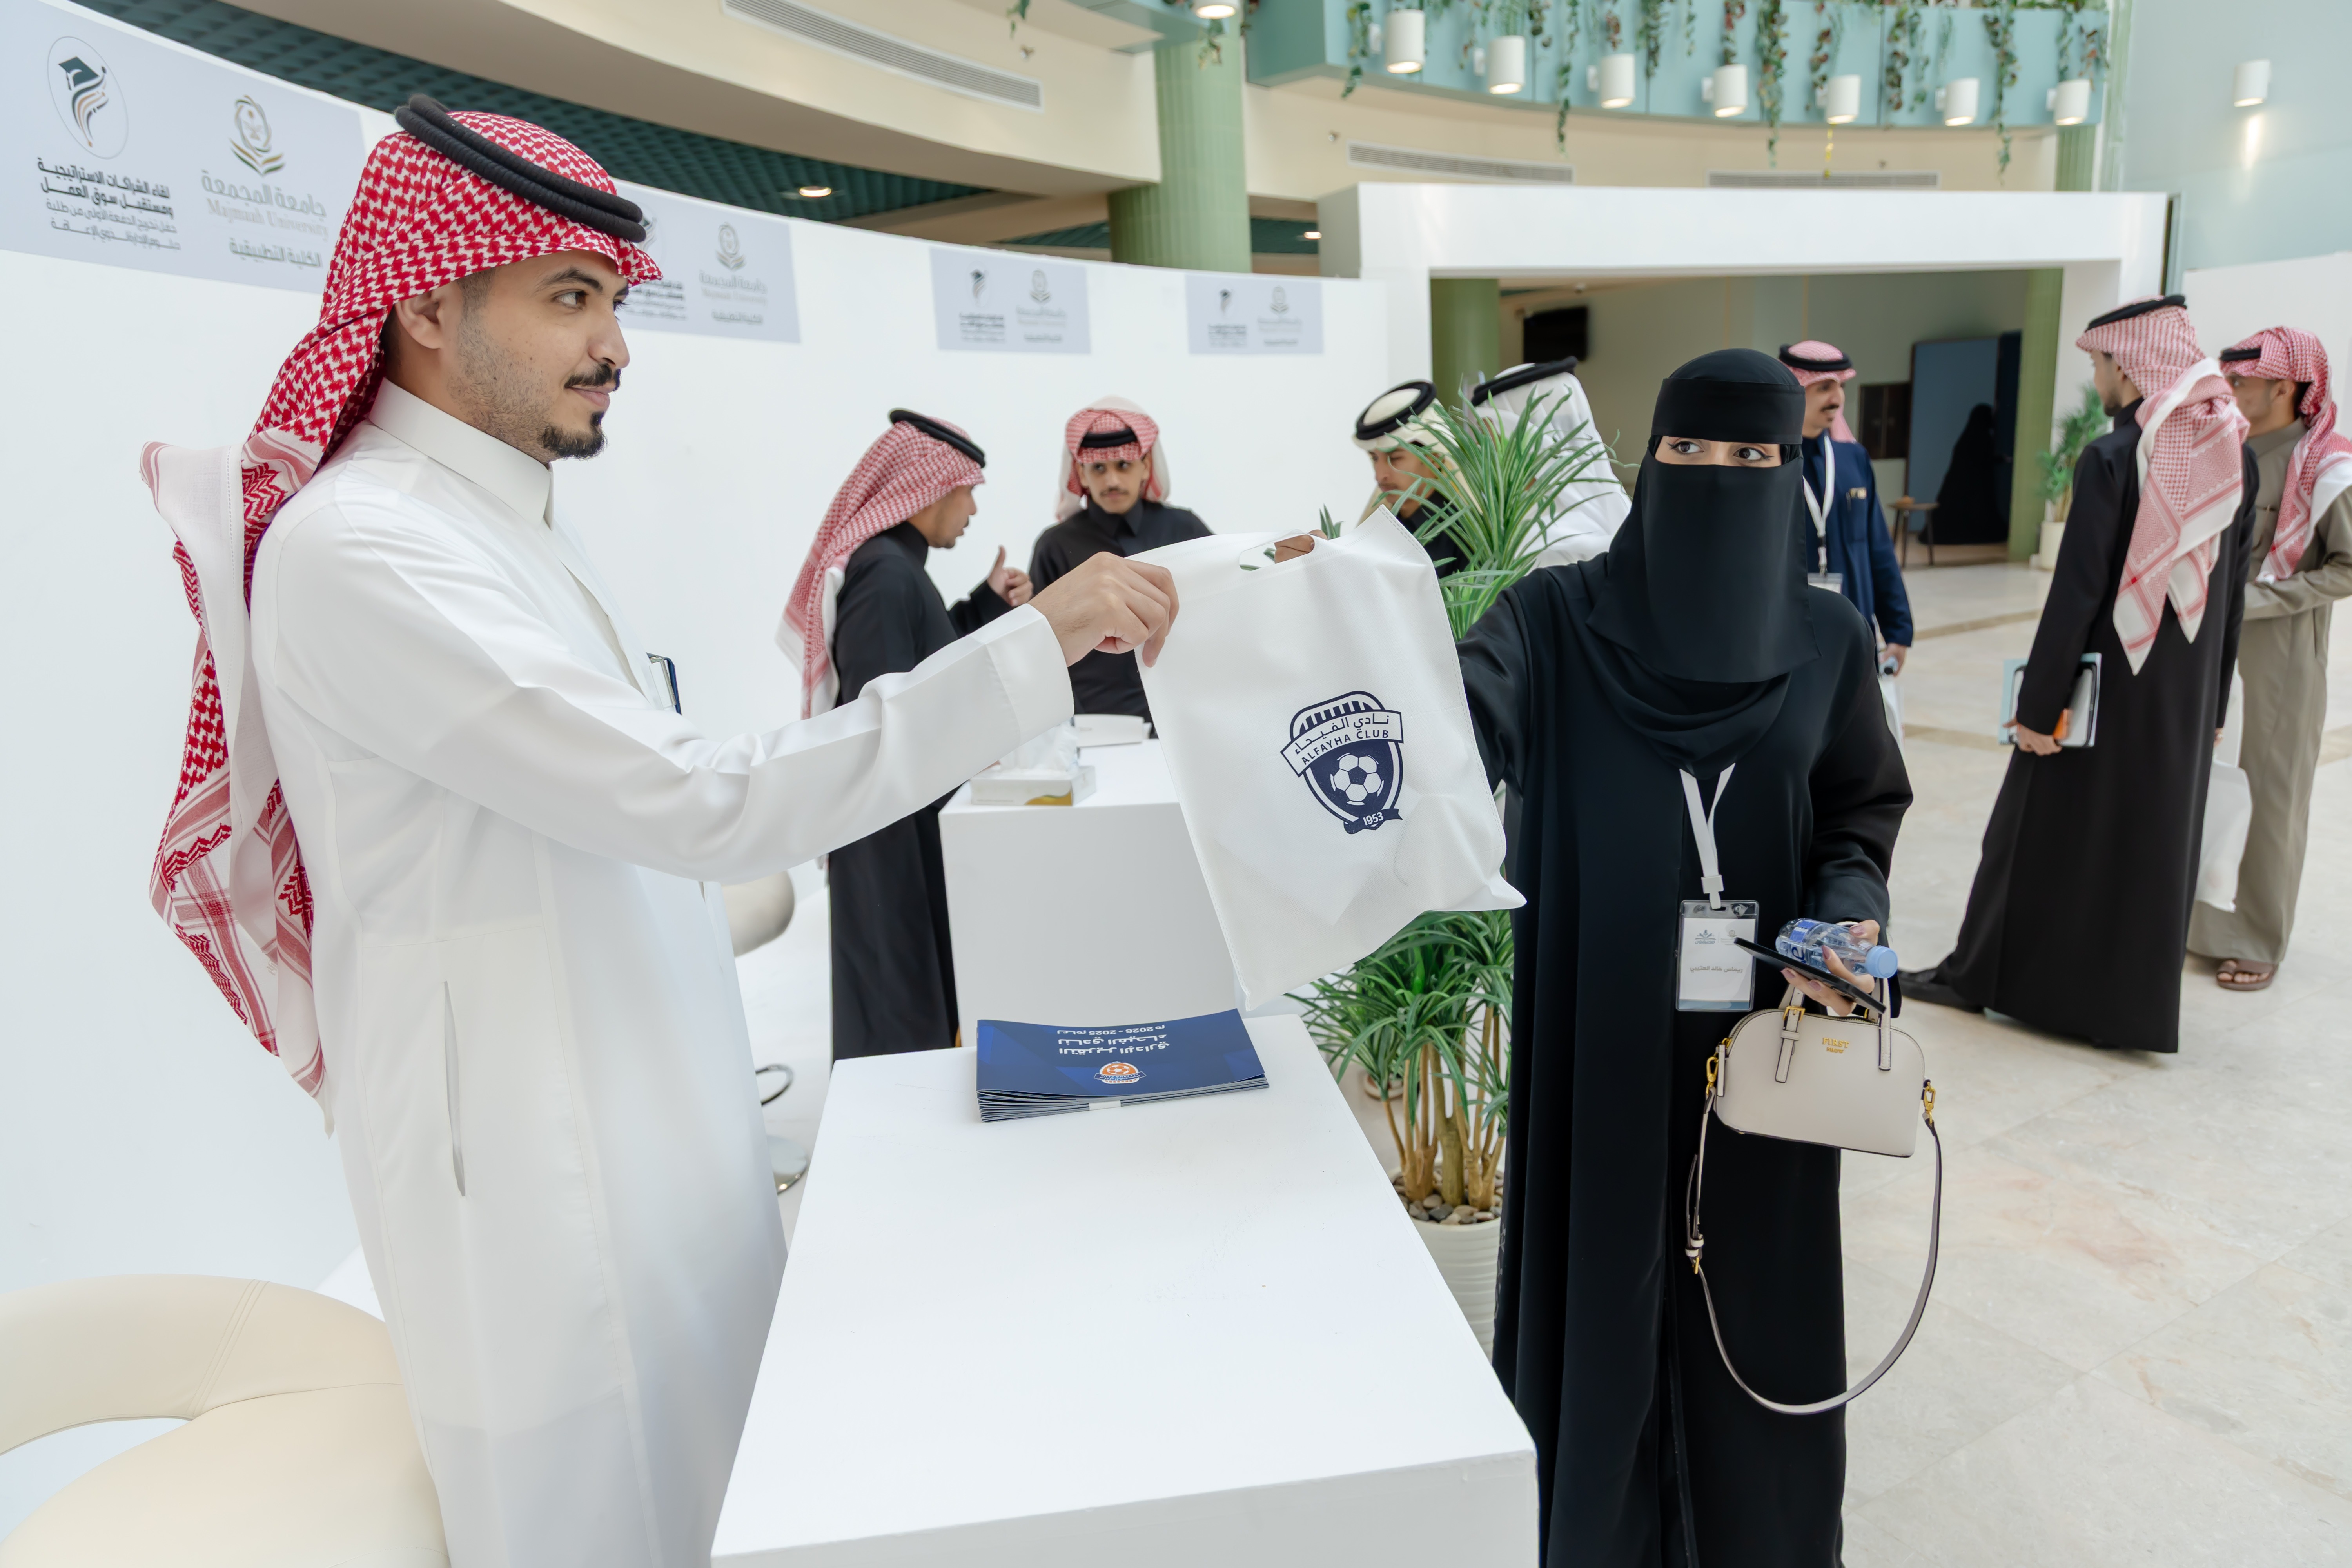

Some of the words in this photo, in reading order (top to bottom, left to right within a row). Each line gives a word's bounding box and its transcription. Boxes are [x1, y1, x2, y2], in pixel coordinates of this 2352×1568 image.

[41, 176, 89, 199] العمل
[106, 175, 151, 195] الشراكات
[152, 183, 170, 199] لقاء
[201, 169, 274, 207] المجمعة
[92, 187, 117, 206] سوق
[119, 194, 174, 220] ومستقبل
[274, 187, 327, 222] جامعة
[229, 237, 286, 263] التطبيقية
[287, 247, 323, 270] الكلية
[1353, 713, 1389, 731] نادي
[1295, 717, 1349, 755] الفيحاء
[1301, 734, 1351, 765] ALFAYHA
[1356, 730, 1388, 739] CLUB
[1363, 811, 1384, 826] 1953
[1058, 1037, 1104, 1045] لنادي
[1108, 1034, 1167, 1045] الفيحاء
[1120, 1041, 1170, 1054] الإداري
[1822, 1038, 1849, 1048] FIRST
